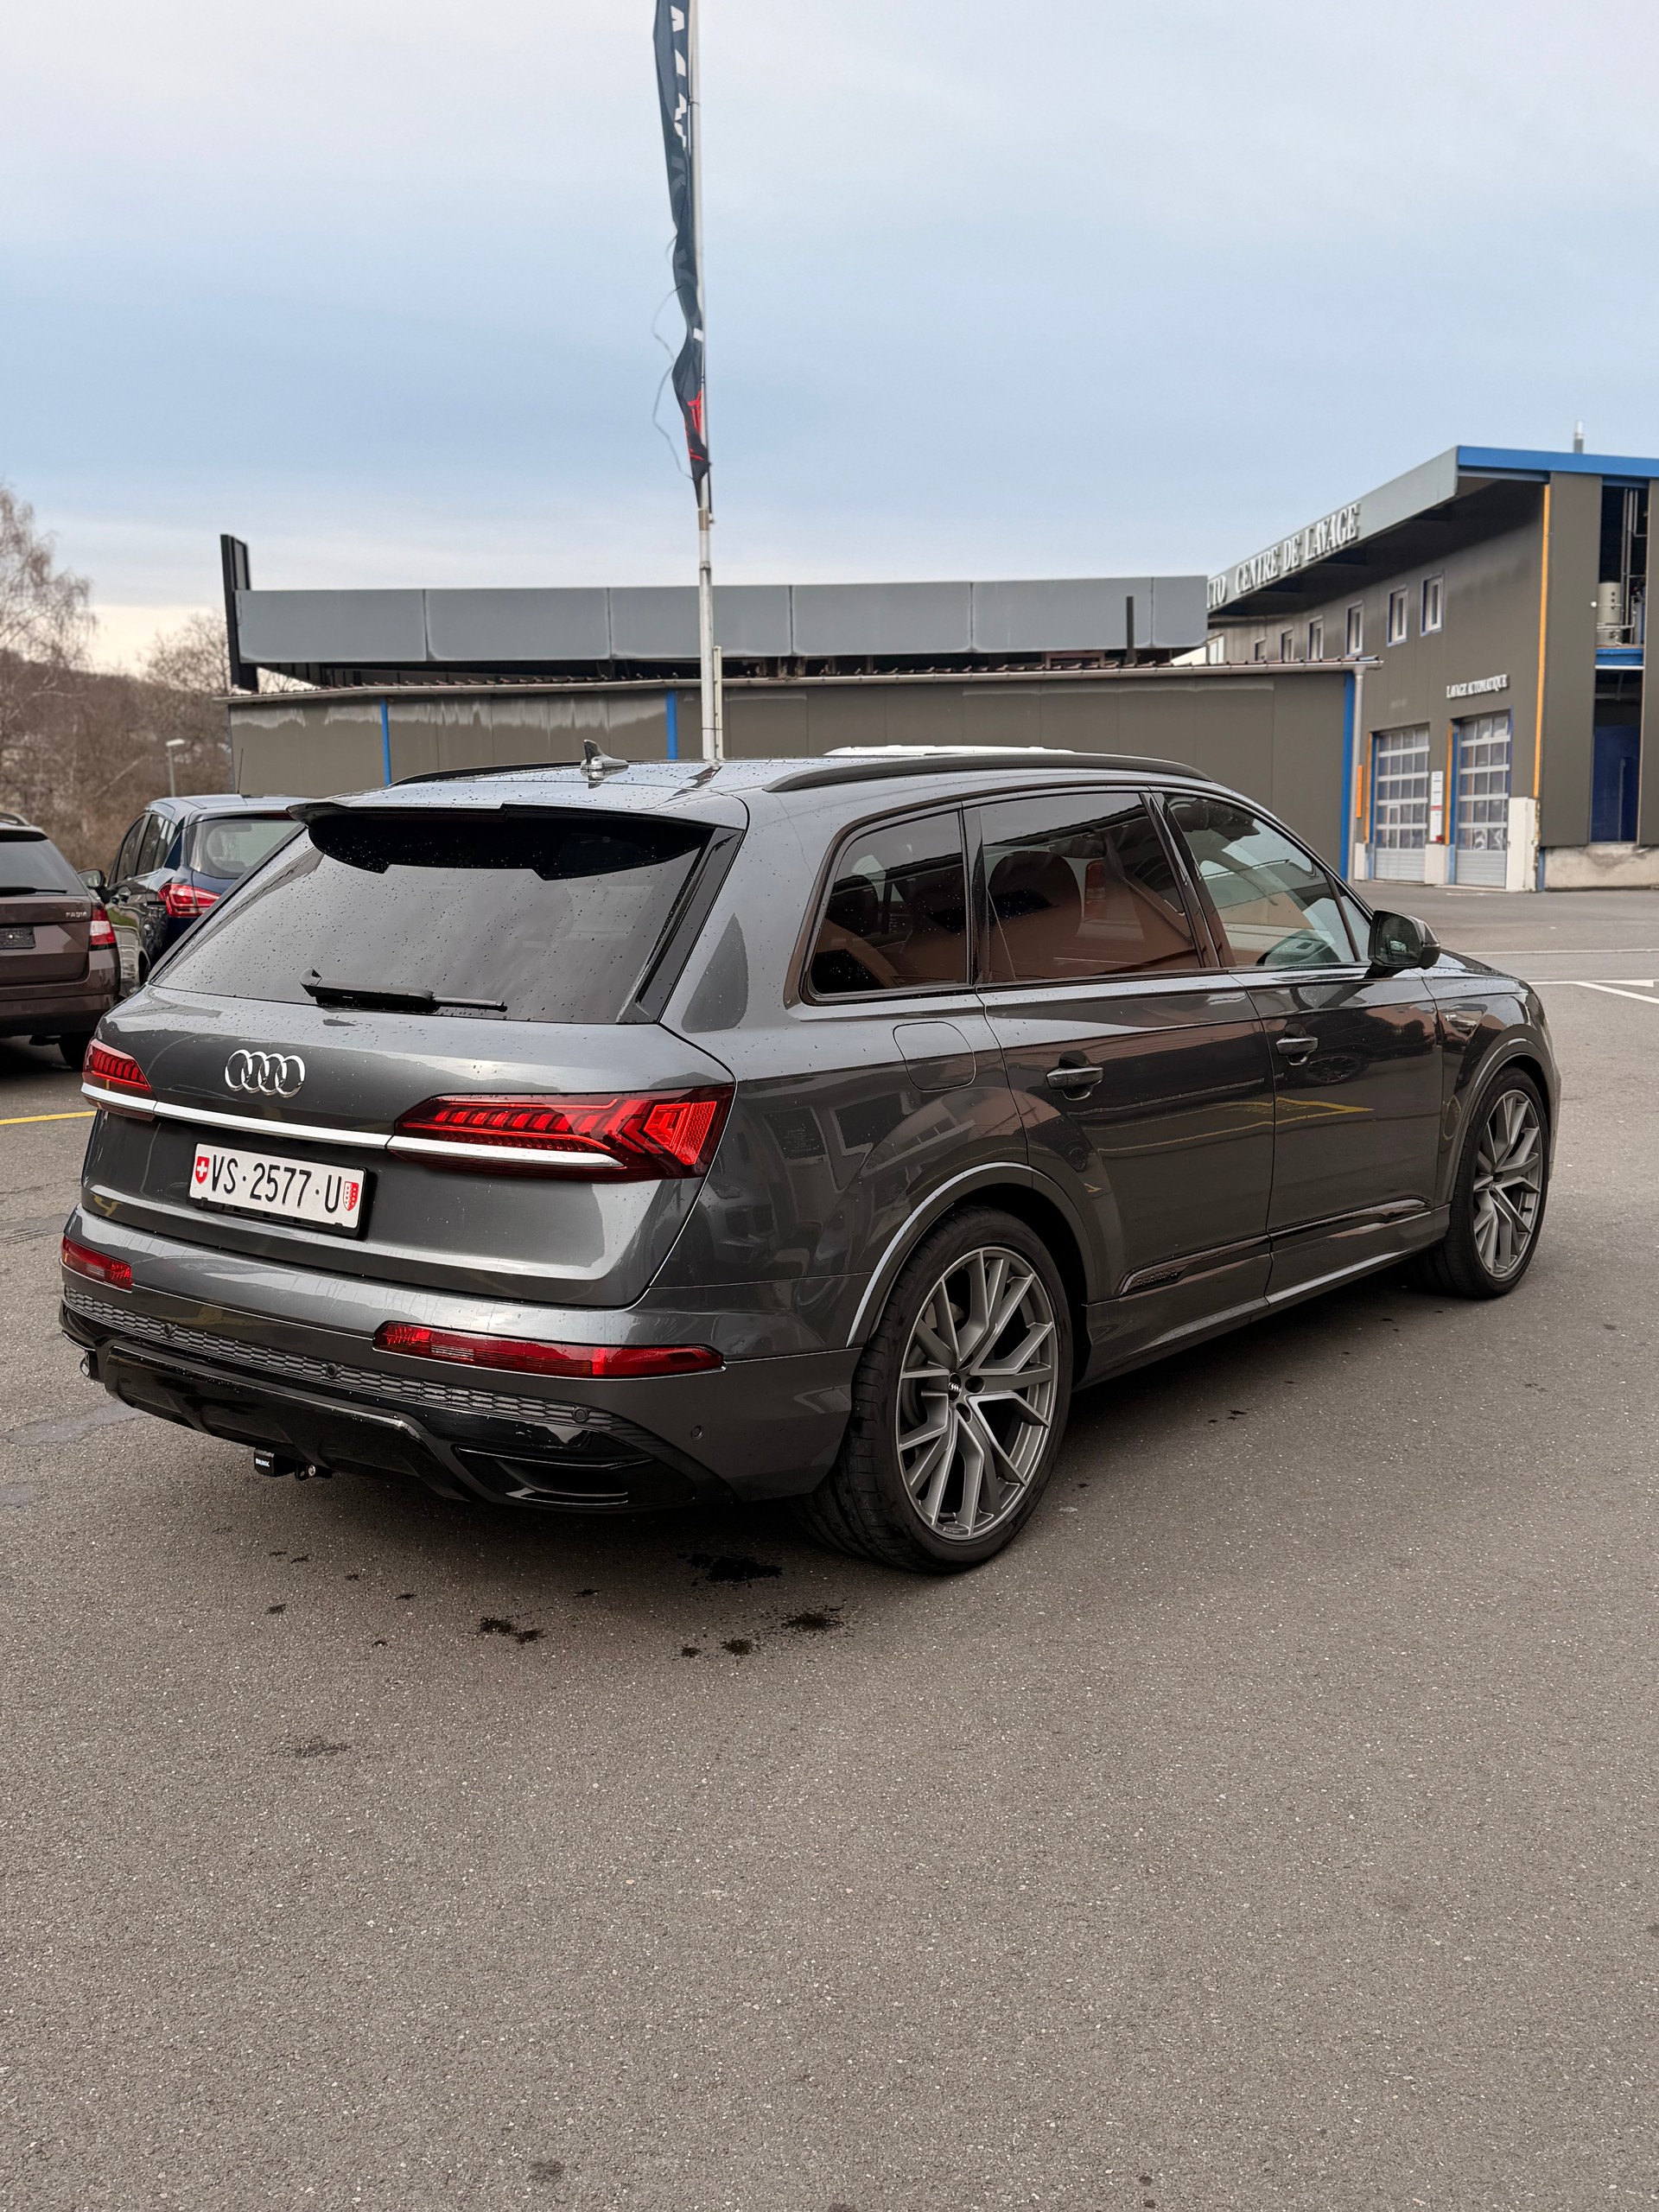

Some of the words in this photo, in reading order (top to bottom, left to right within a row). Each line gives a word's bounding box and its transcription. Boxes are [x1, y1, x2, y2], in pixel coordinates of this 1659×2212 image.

[1235, 546, 1279, 594] CENTRE
[1283, 535, 1300, 572] DE
[1305, 501, 1360, 561] LAVAGE
